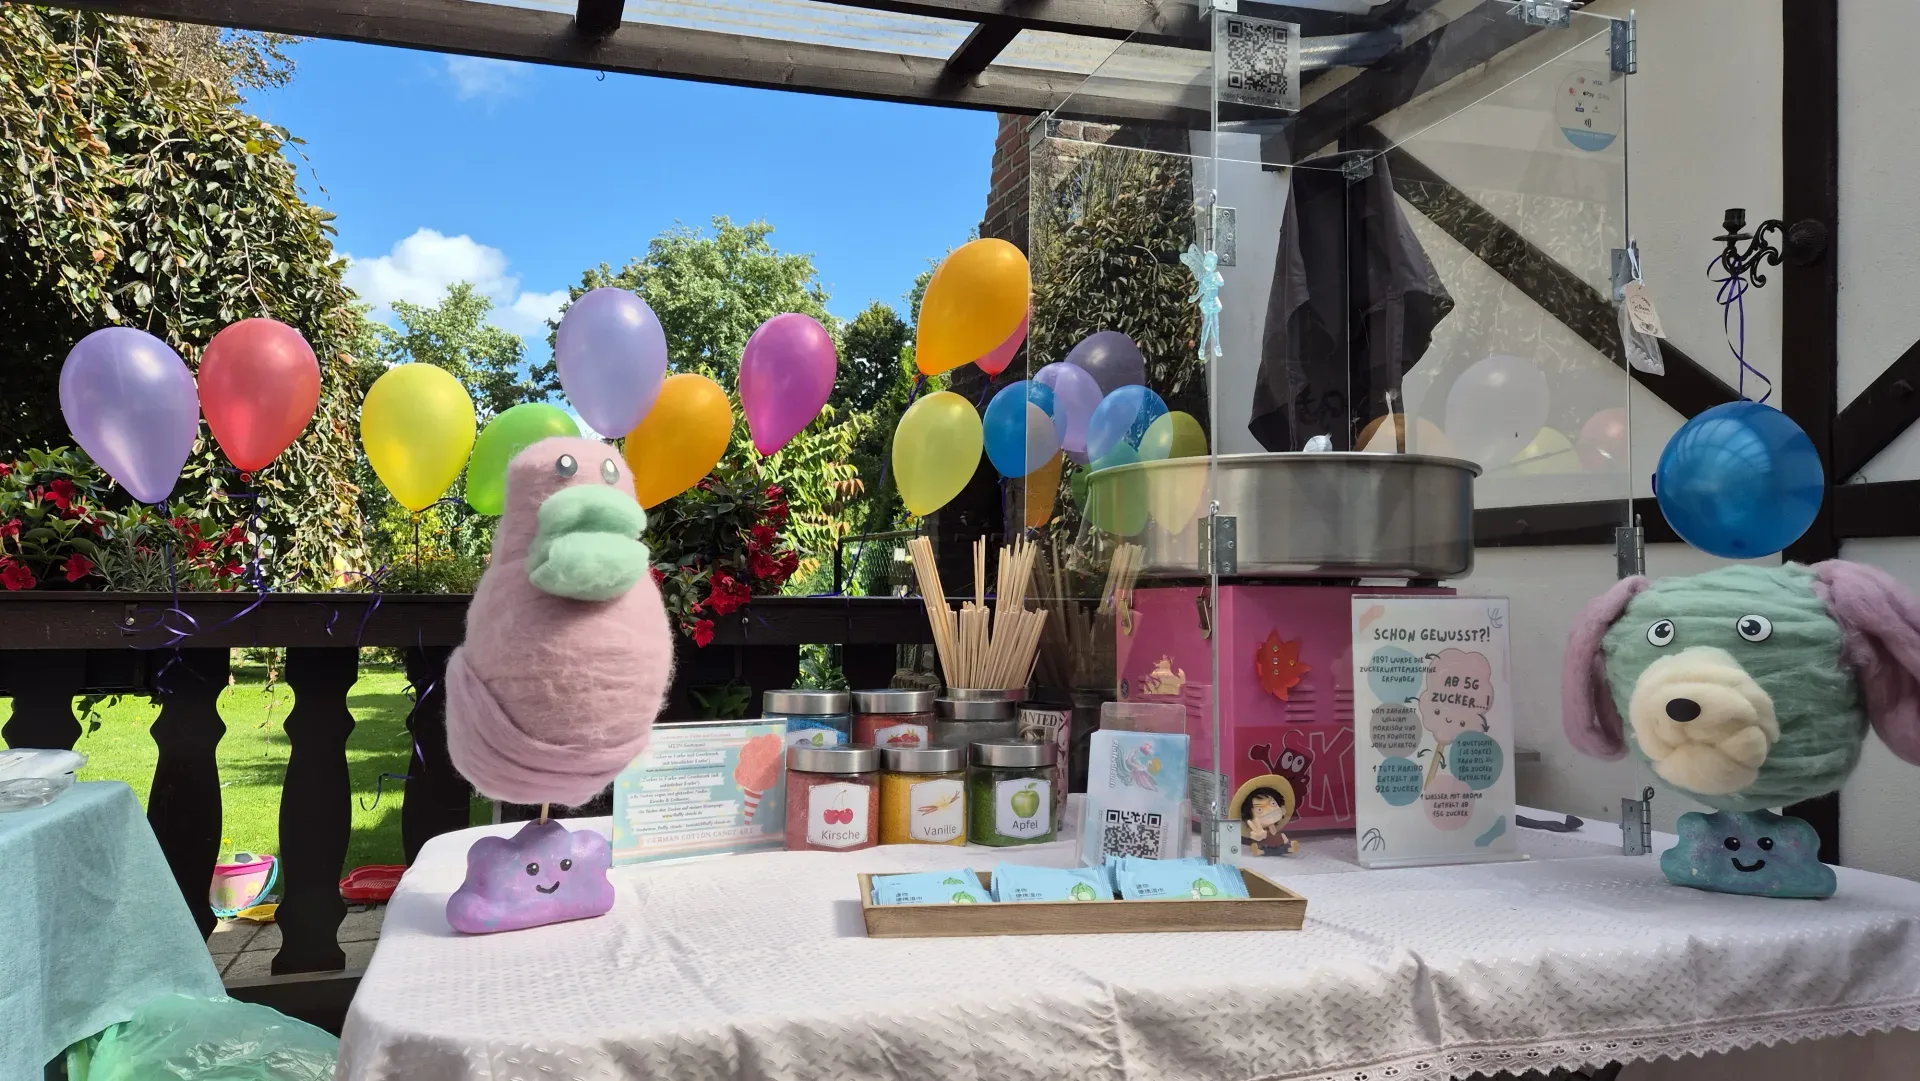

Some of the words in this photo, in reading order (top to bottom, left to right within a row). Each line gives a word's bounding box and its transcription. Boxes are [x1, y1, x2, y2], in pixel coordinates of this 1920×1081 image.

[1374, 628, 1416, 642] SCHON
[1420, 626, 1490, 642] GEWUSST?!
[1372, 656, 1388, 664] 1897
[1444, 676, 1460, 688] AB
[1464, 677, 1480, 690] 5G
[1020, 709, 1058, 727] ANTED
[1375, 785, 1390, 794] 92G
[923, 823, 957, 836] Vanille
[1012, 820, 1038, 832] Apfel
[647, 834, 679, 843] GERMAN
[681, 832, 711, 840] COTTON
[712, 829, 737, 837] CANDY
[820, 829, 860, 841] Kirsche
